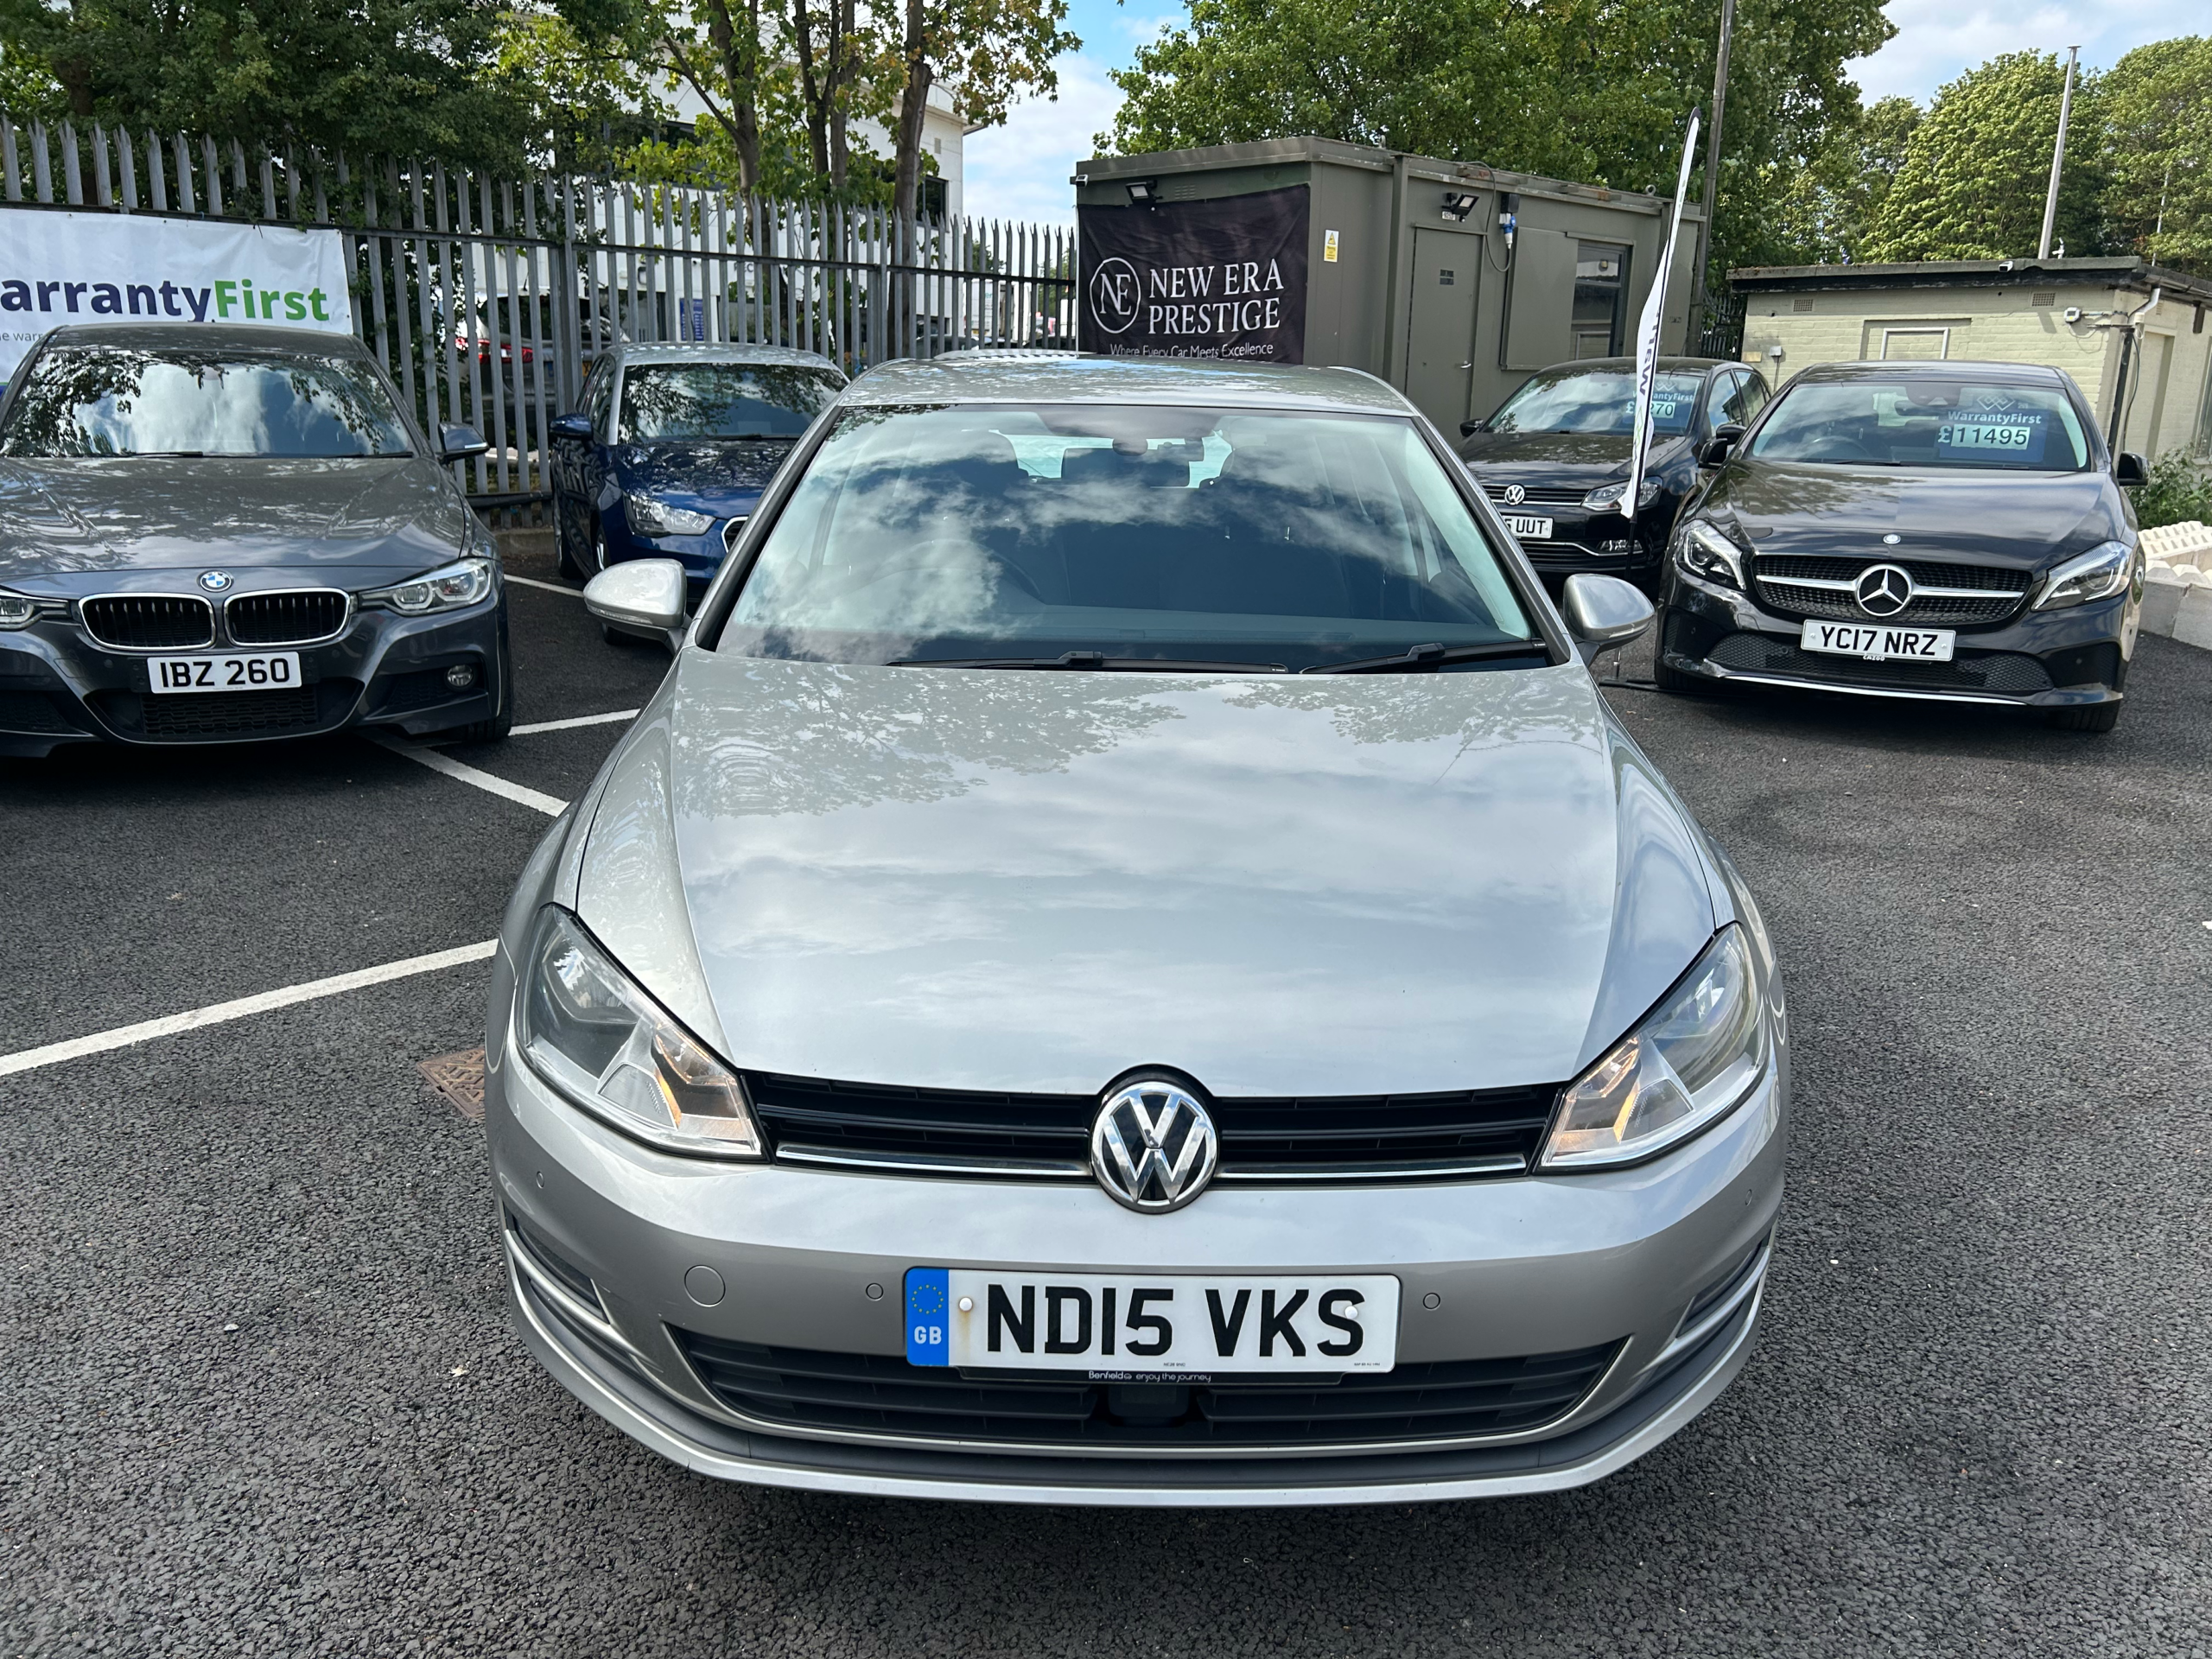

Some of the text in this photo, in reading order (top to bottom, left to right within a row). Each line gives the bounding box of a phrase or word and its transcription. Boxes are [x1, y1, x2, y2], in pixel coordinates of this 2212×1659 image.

[1148, 258, 1285, 299] NEW ERA
[0, 278, 330, 322] arrantyFirst
[1147, 297, 1281, 335] PRESTIGE
[1109, 343, 1141, 357] Where
[1171, 346, 1189, 358] Car
[1190, 345, 1220, 359] Meets
[1221, 342, 1274, 358] Excellence
[1947, 410, 2043, 425] WarrantyFirst
[1937, 425, 2028, 446] £11495
[1516, 518, 1547, 535] UUT
[1821, 626, 1938, 657] YC17 NRZ
[160, 658, 289, 688] IBZ 260
[987, 1284, 1365, 1357] ND15 VKS
[913, 1325, 943, 1345] GB
[1088, 1370, 1211, 1382] Benfield enjoy the journey
